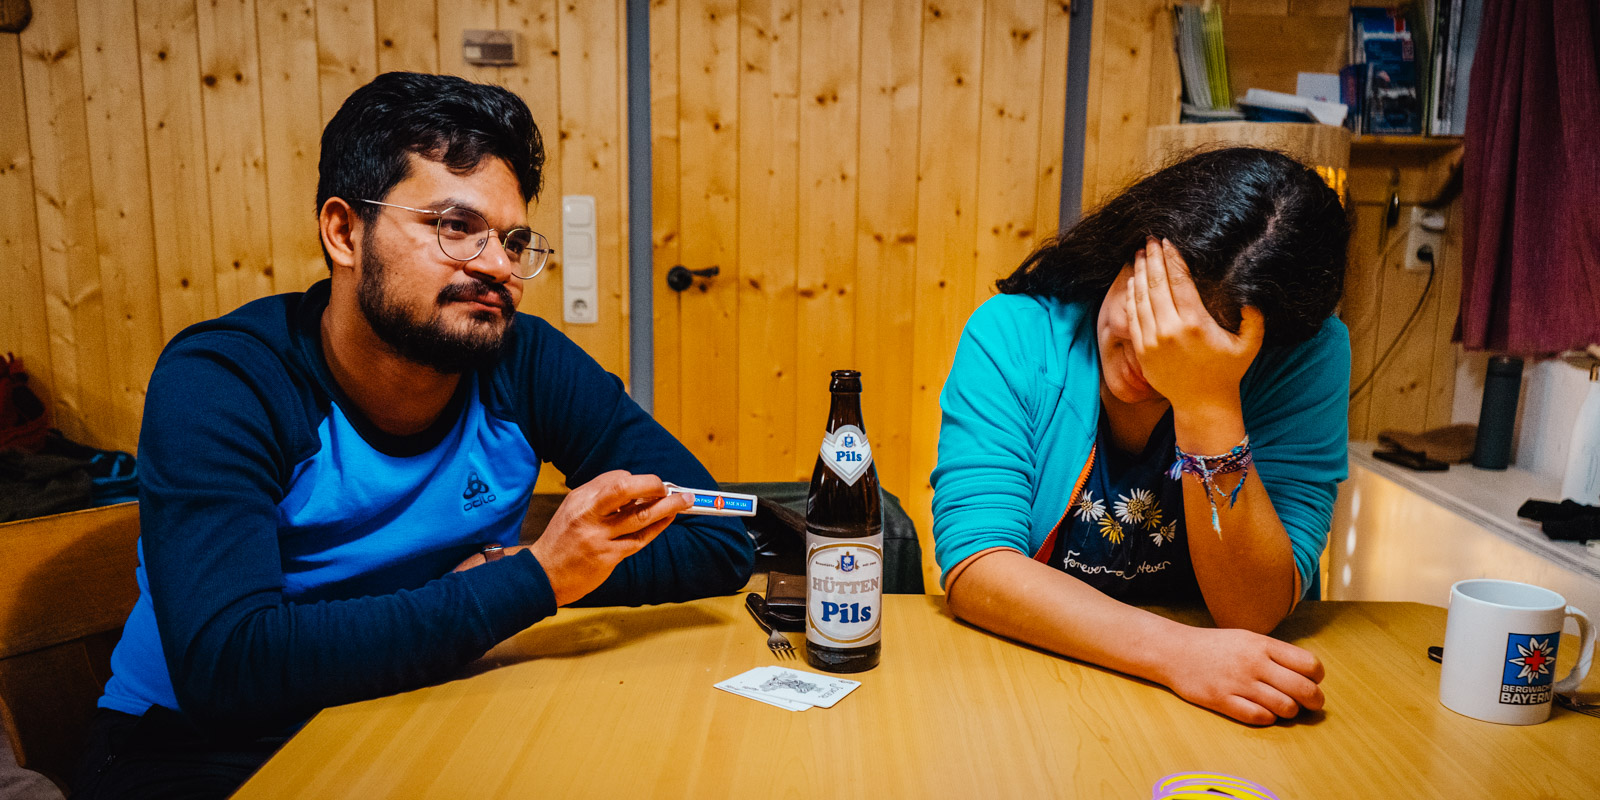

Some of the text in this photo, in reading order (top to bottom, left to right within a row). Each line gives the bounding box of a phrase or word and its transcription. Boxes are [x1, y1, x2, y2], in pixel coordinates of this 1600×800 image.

[836, 450, 862, 462] Pils
[812, 576, 880, 595] HÜTTEN
[820, 600, 872, 624] Pils
[1501, 692, 1551, 704] BAYERN
